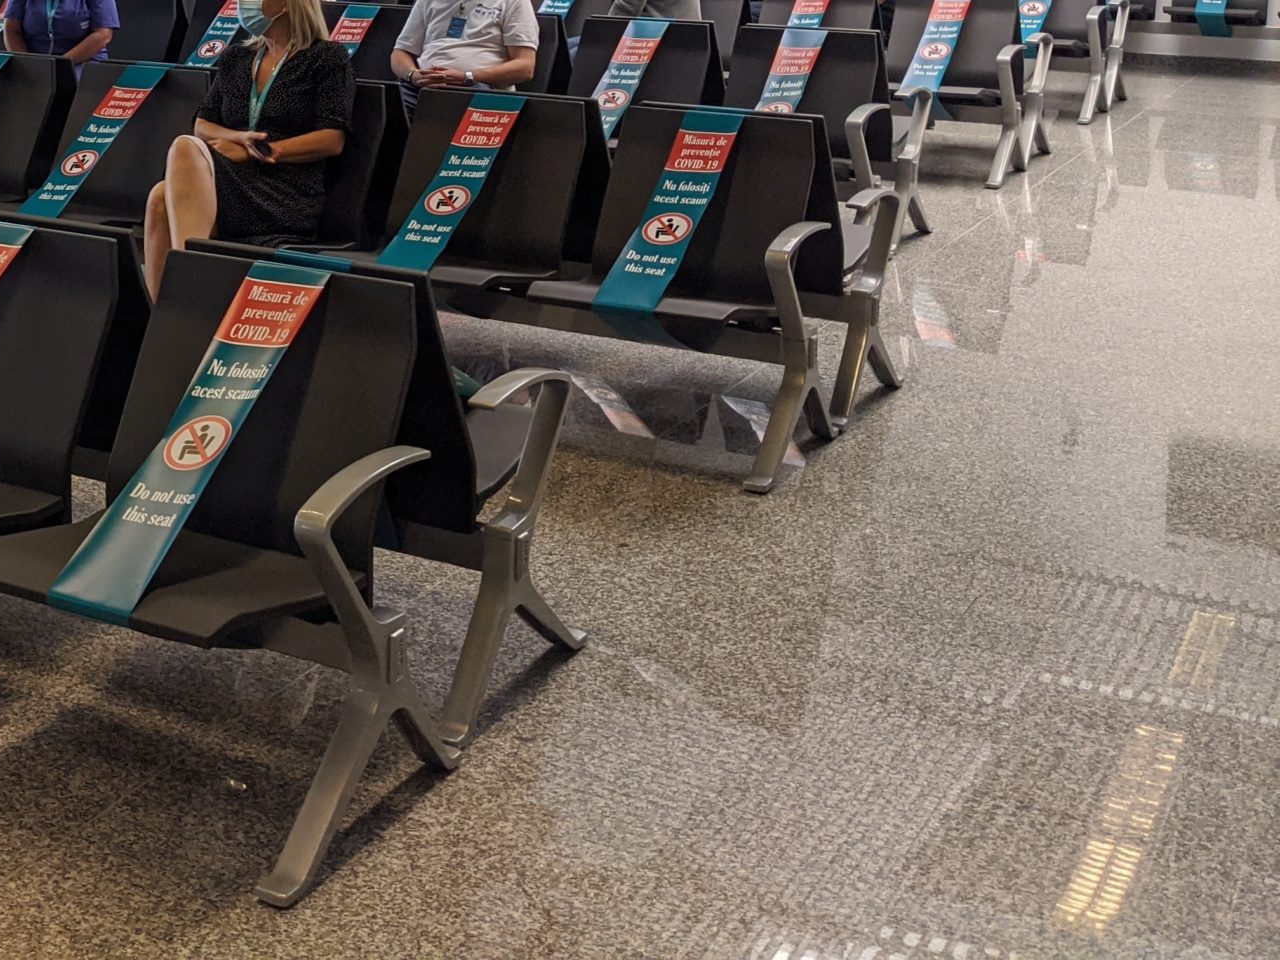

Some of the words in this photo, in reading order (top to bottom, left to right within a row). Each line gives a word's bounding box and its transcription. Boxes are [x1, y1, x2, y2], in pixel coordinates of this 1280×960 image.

[470, 112, 499, 123] Măsură
[500, 114, 510, 124] de
[87, 123, 97, 132] Nu
[467, 123, 504, 135] prevenție
[460, 134, 500, 145] COVID-19
[683, 134, 716, 146] Măsură
[716, 136, 728, 147] de
[681, 147, 721, 159] prevenție
[448, 154, 460, 165] Nu
[674, 158, 719, 169] COVID-19
[439, 168, 462, 177] acest
[463, 170, 486, 178] scaun
[44, 182, 52, 190] Do
[662, 180, 677, 191] Nu
[678, 180, 711, 194] folosiți
[39, 192, 52, 200] this
[52, 193, 67, 201] seat
[654, 193, 679, 204] acest
[680, 196, 708, 205] scaun
[407, 220, 421, 230] Do
[422, 222, 436, 232] not
[437, 224, 452, 232] use
[405, 232, 421, 242] this
[422, 234, 441, 244] seat
[626, 249, 641, 261] Do
[642, 253, 659, 263] not
[660, 255, 678, 264] use
[624, 263, 643, 274] this
[644, 267, 667, 276] seat
[248, 285, 292, 305] Măsură
[293, 291, 309, 306] de
[241, 307, 297, 325] prevenție
[229, 323, 291, 341] COVID-19
[207, 358, 226, 377] Nu
[227, 362, 272, 383] folosiți
[191, 382, 225, 399] acest
[225, 388, 260, 400] scaun
[130, 481, 149, 499] Do
[152, 488, 175, 503] not
[176, 493, 196, 505] use
[122, 504, 146, 524] this
[147, 511, 176, 528] seat
